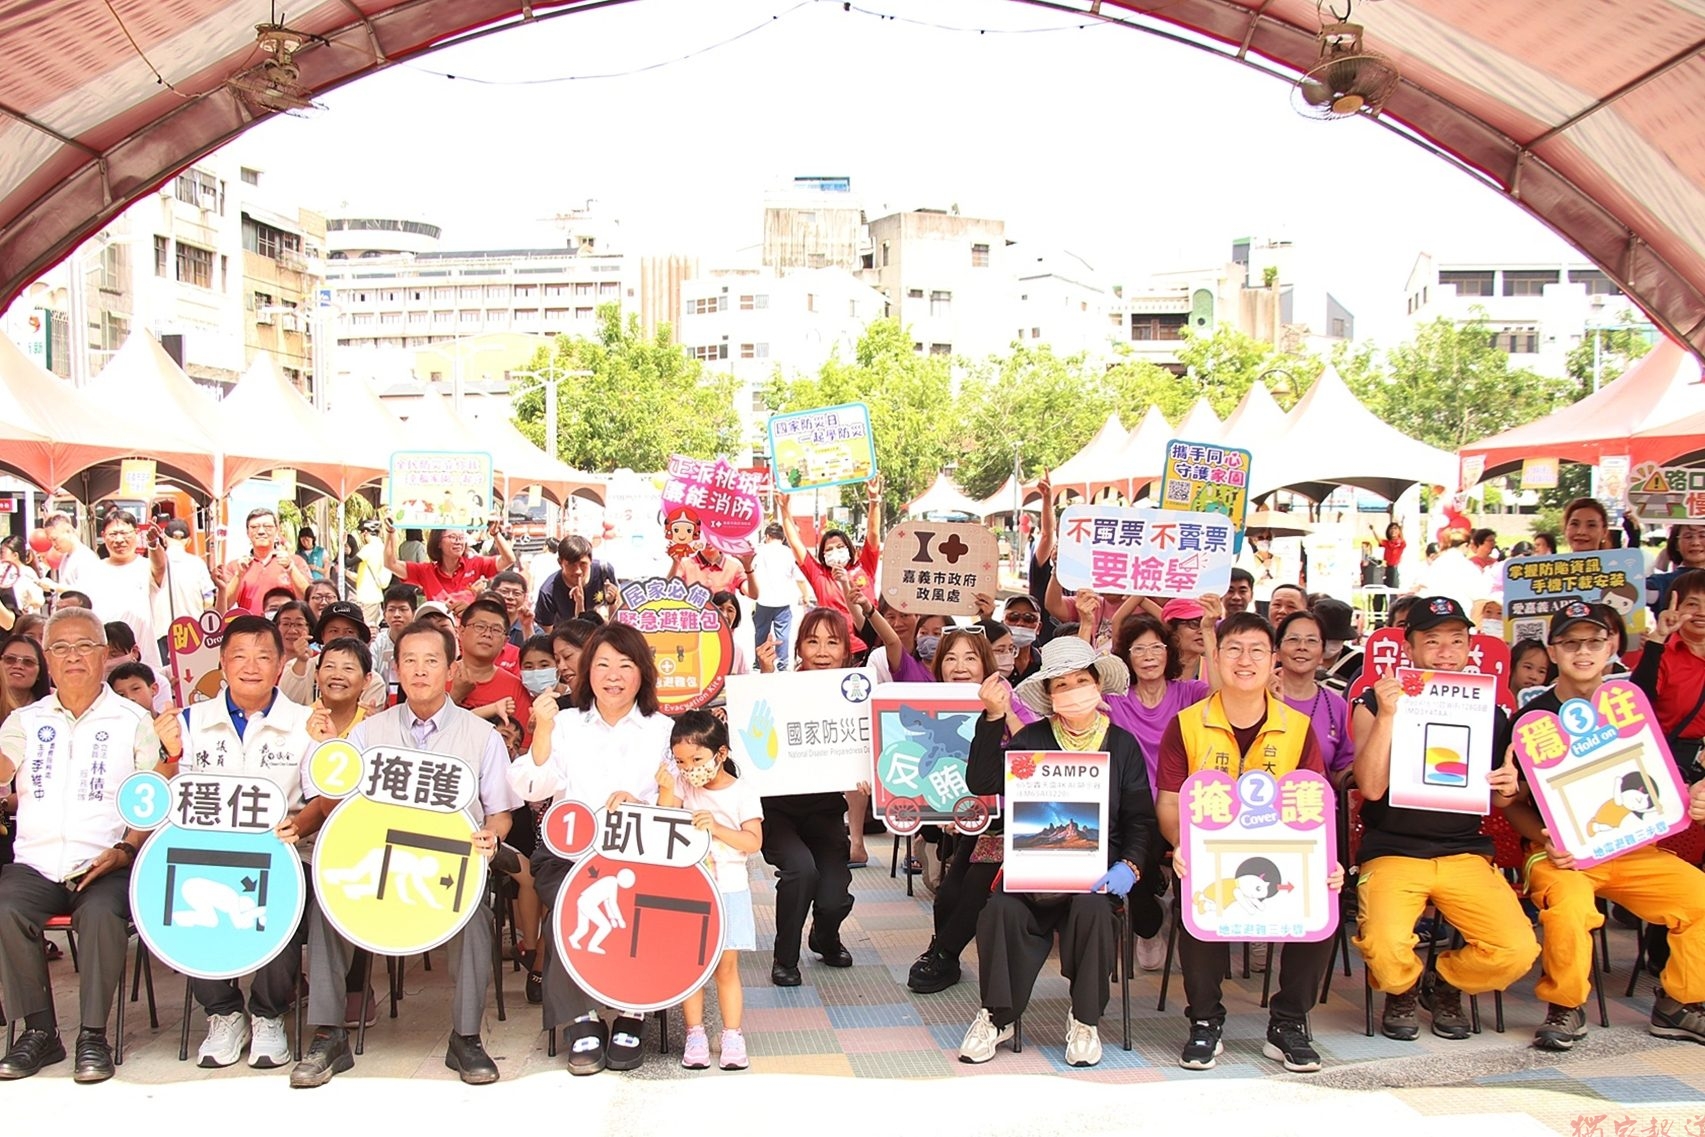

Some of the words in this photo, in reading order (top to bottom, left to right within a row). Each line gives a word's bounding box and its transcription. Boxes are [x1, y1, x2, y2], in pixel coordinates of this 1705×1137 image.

[1172, 444, 1241, 467] 攜手同心
[669, 456, 761, 496] 正派桃城
[1176, 463, 1244, 487] 守護家園
[1665, 470, 1705, 492] 路口
[662, 480, 755, 521] 廉能消防
[1067, 518, 1145, 547] 不買票
[1150, 523, 1229, 552] 不賣票
[903, 570, 977, 587] 嘉義市政府
[1092, 550, 1198, 593] 要檢舉
[1531, 572, 1625, 594] 手機下載安裝
[624, 580, 709, 609] 居家必備
[916, 587, 960, 603] 政風處
[619, 610, 719, 631] 緊急避難包
[173, 622, 201, 651] 趴
[1430, 684, 1480, 699] APPLE
[787, 716, 870, 746] 國家防災日
[1518, 714, 1567, 765] 穩
[1598, 686, 1645, 730] 住
[1569, 707, 1588, 729] 3
[1573, 736, 1600, 756] Hold
[1601, 727, 1616, 741] on
[196, 750, 211, 768] 陳
[323, 751, 346, 787] 2
[1042, 765, 1100, 778] SAMPO
[366, 752, 463, 810] 掩護
[1249, 778, 1265, 802] 2
[133, 782, 155, 818] 3
[177, 780, 271, 829] 穩住
[1189, 780, 1234, 824] 掩
[1280, 780, 1325, 824] 護
[563, 811, 577, 846] 1
[1241, 811, 1278, 827] Cover
[602, 809, 692, 860] 趴下
